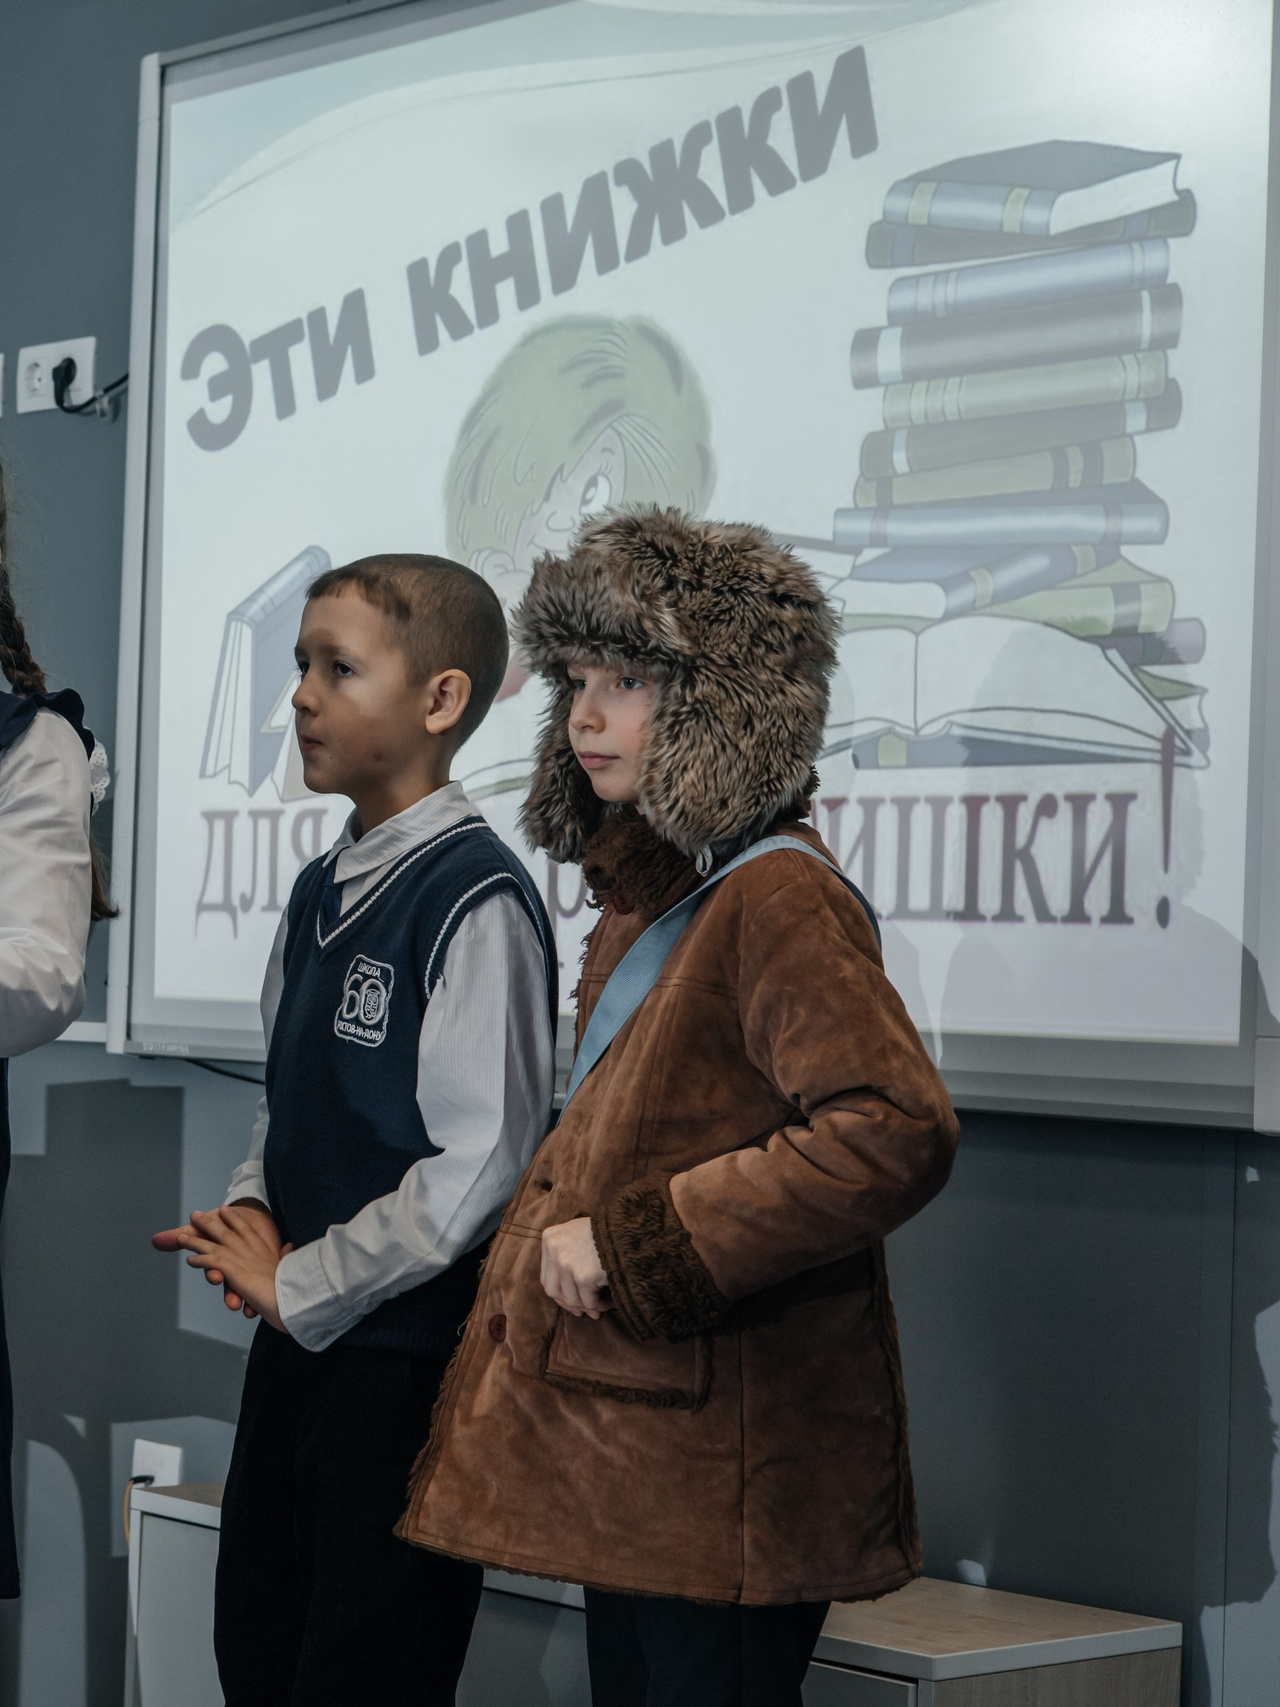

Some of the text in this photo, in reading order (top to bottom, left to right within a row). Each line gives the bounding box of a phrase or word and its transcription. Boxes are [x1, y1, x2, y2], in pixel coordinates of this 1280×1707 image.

[180, 44, 880, 452] Эти книжки
[357, 961, 381, 979] ШКОЛА
[342, 973, 388, 1026] 60
